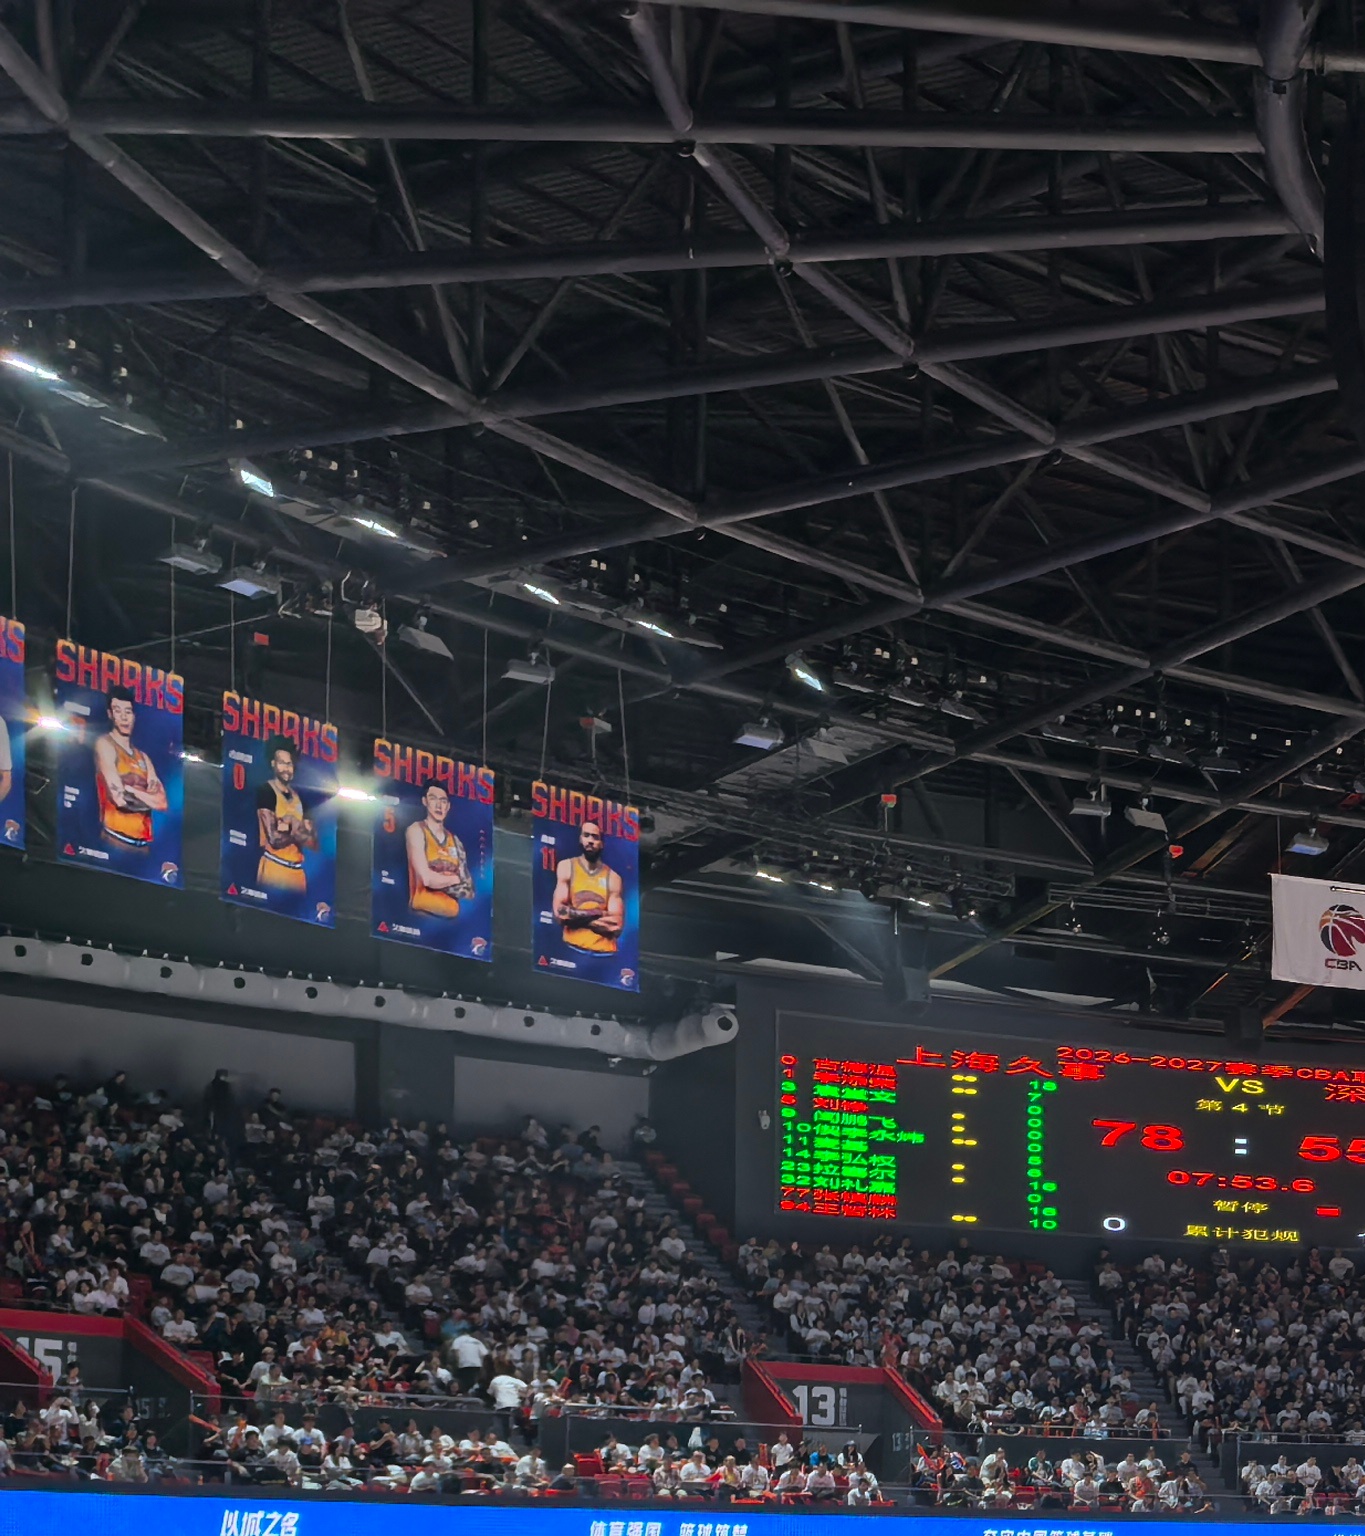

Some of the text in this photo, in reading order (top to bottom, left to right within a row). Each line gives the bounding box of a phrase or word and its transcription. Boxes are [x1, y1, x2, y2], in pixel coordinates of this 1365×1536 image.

[55, 638, 184, 714] SHARKS
[222, 690, 338, 762] SHARKS
[374, 737, 495, 805] SHARKS
[531, 780, 640, 842] SHARKS
[1324, 957, 1363, 972] CBA
[1215, 1076, 1265, 1095] VS
[1091, 1118, 1185, 1151] 78
[1167, 1170, 1315, 1193] 07:53.6
[1103, 1216, 1126, 1232] 0
[1183, 1224, 1300, 1243] 累计犯规
[793, 1386, 835, 1426] 13
